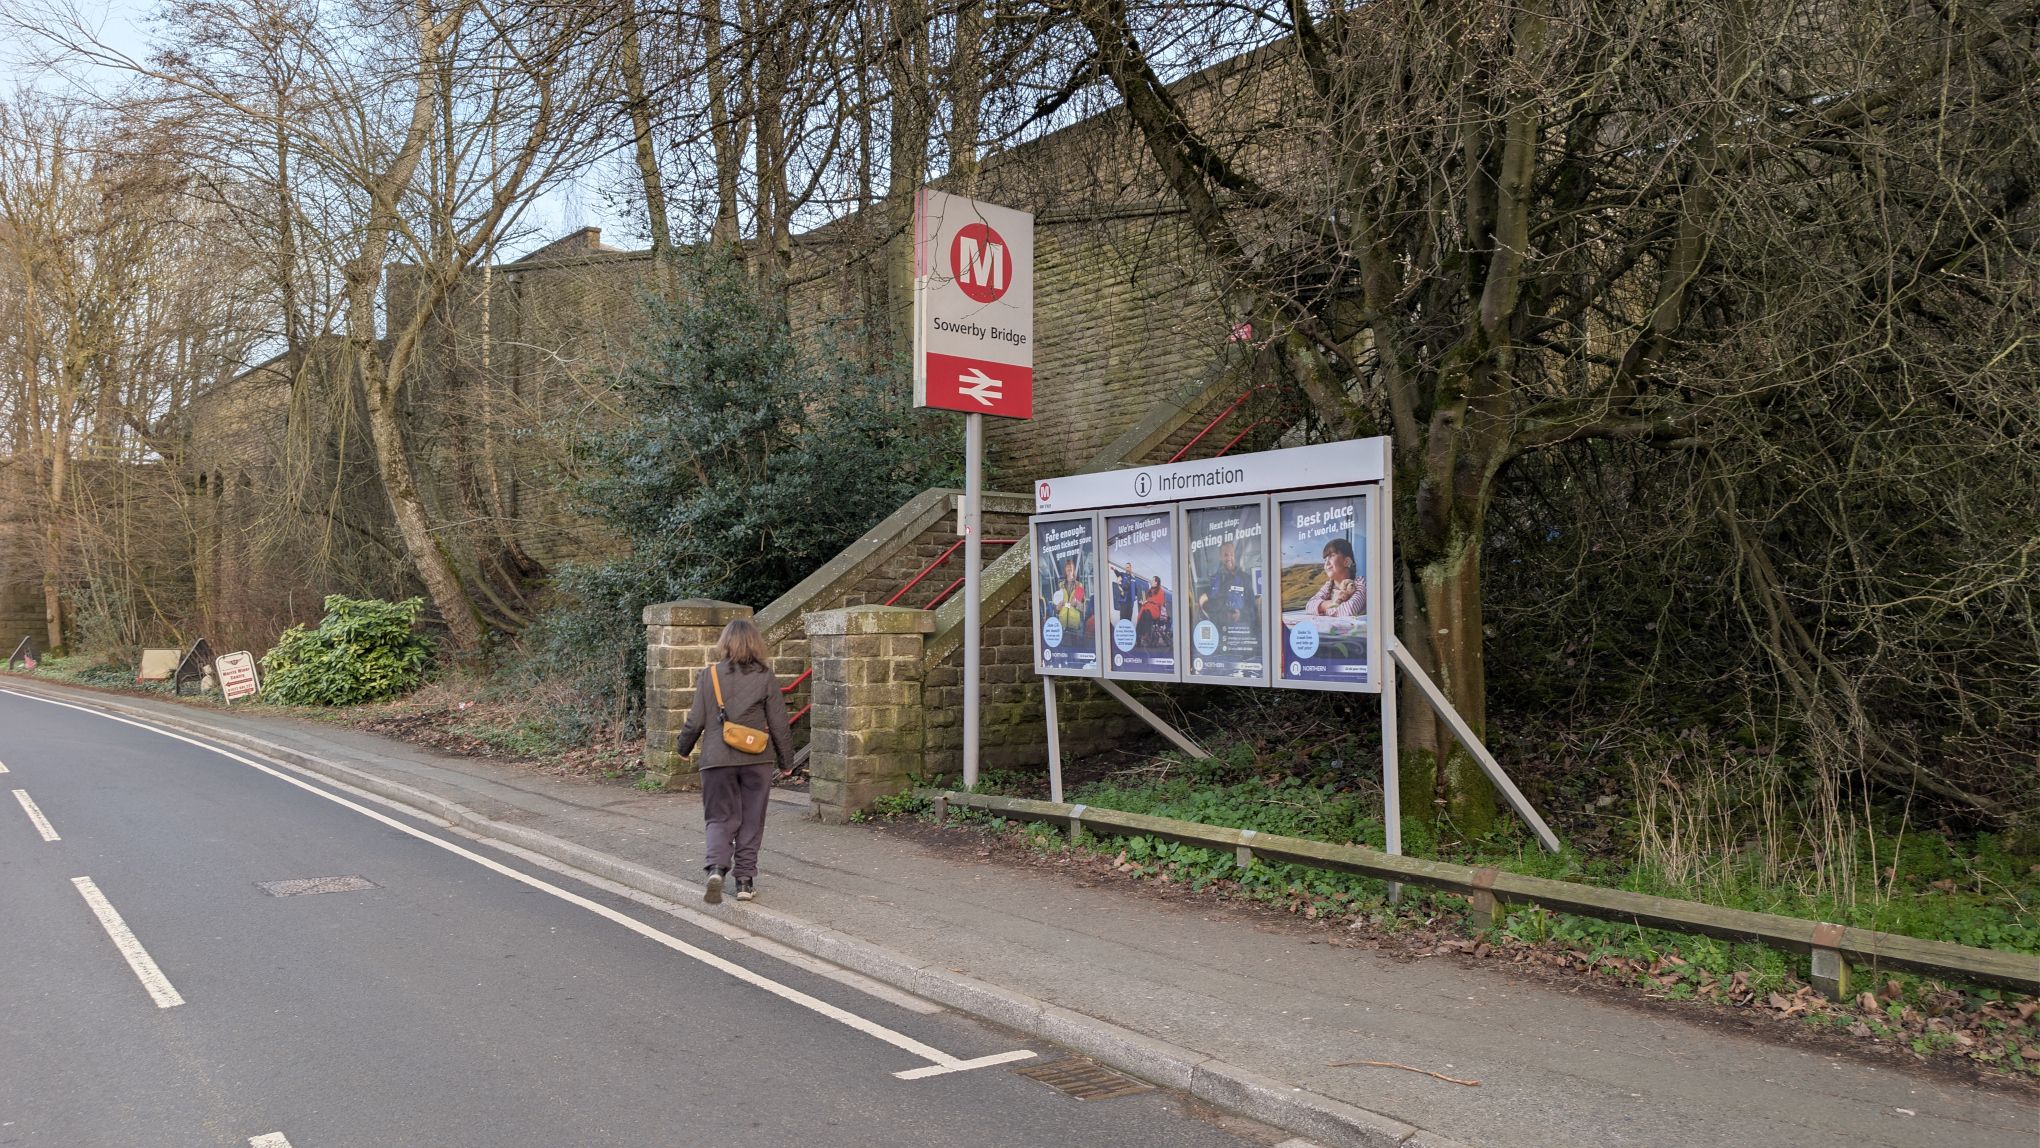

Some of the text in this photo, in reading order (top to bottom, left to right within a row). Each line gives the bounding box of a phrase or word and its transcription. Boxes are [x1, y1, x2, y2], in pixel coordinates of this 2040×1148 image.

[933, 317, 1027, 346] Sowerby Bridge
[1159, 467, 1243, 491] Information
[1118, 518, 1161, 534] We're Northern
[1209, 519, 1240, 531] Next stop:
[1296, 505, 1354, 528] Best place
[1060, 524, 1086, 539] enough:
[1114, 527, 1168, 552] just like you
[1224, 531, 1234, 543] in
[1235, 523, 1262, 540] touch
[1298, 531, 1306, 540] in
[1314, 522, 1339, 537] world,
[1340, 518, 1355, 530] this
[1061, 539, 1079, 549] tickets
